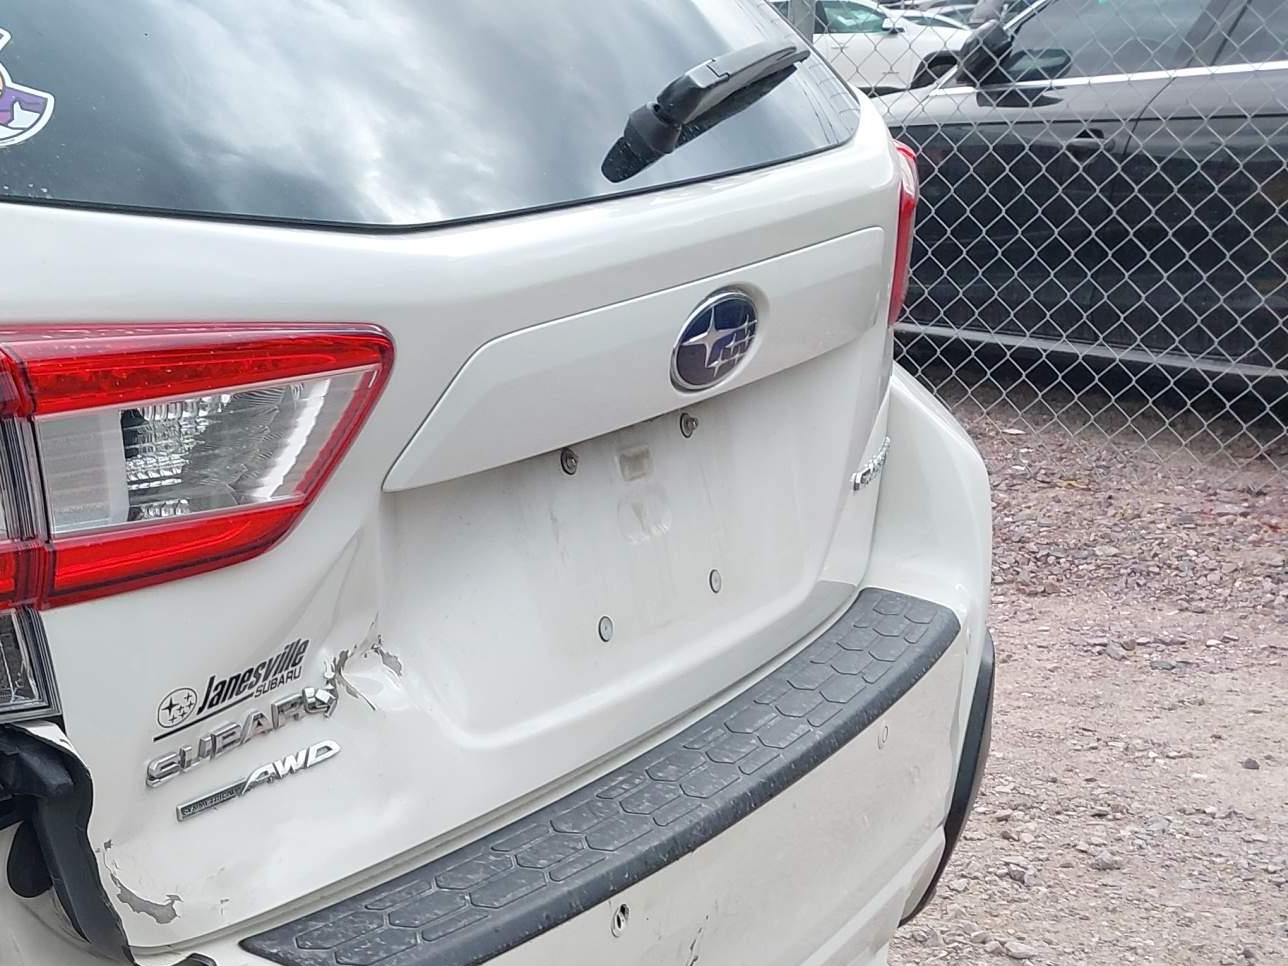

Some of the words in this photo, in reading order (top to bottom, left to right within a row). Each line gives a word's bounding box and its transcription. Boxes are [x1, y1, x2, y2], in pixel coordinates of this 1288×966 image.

[197, 638, 310, 714] Janesville
[254, 666, 303, 698] SUBARU
[242, 740, 341, 795] AWD
